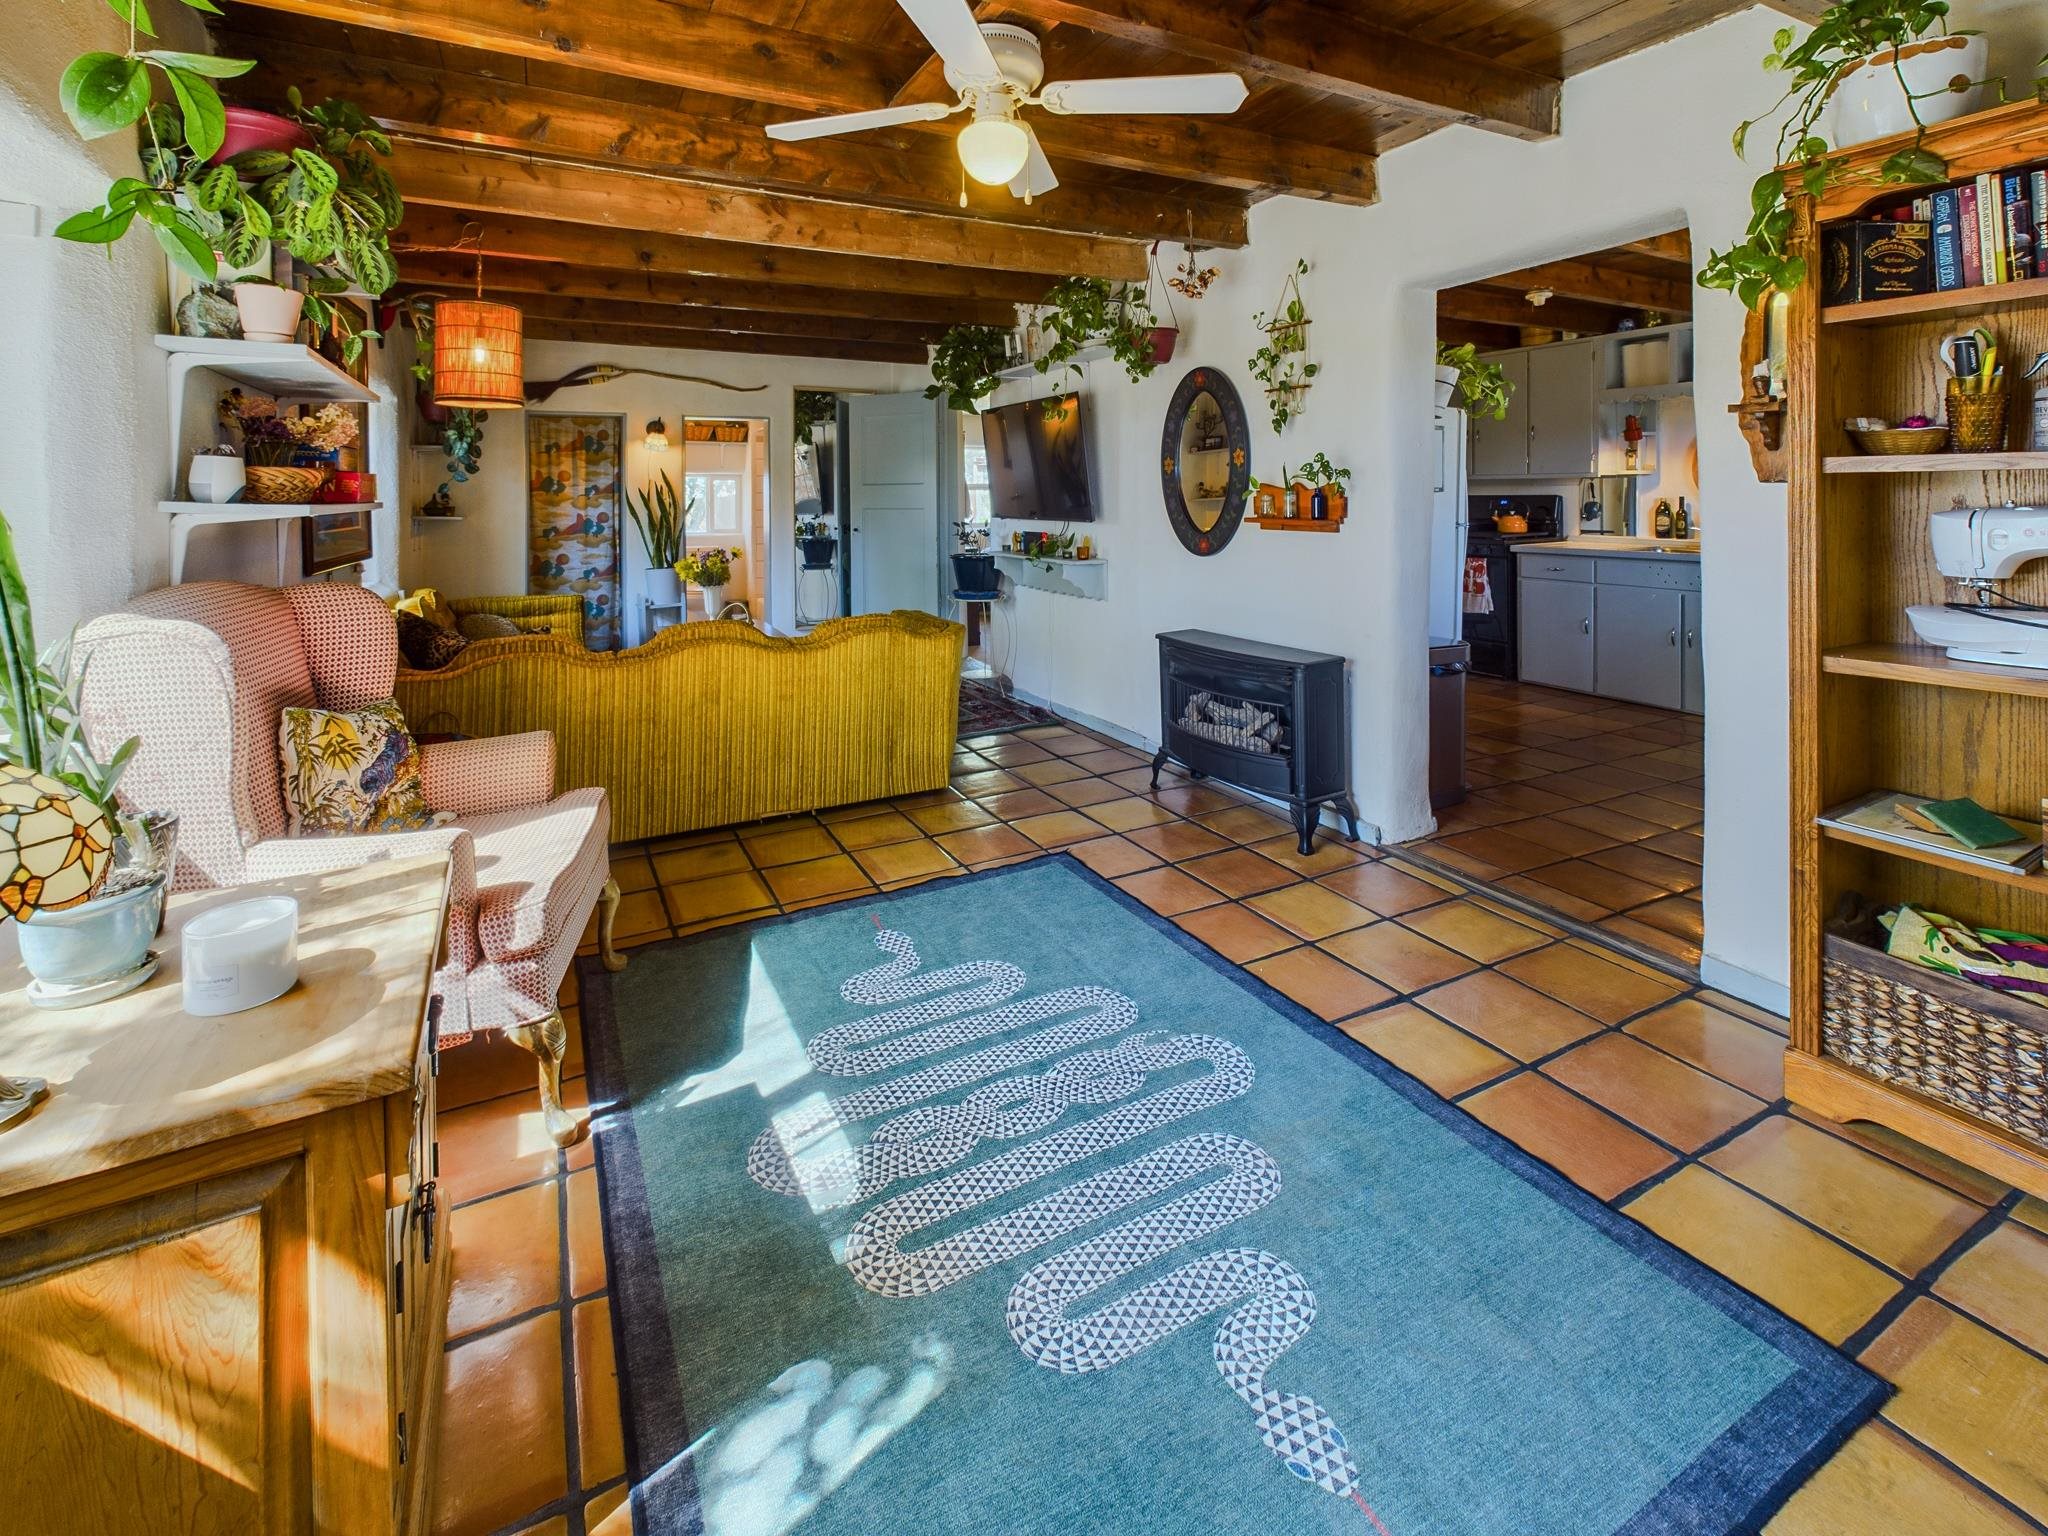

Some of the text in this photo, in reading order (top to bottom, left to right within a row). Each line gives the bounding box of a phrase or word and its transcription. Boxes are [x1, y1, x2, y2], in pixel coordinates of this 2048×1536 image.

[2005, 178, 2015, 204] Birds
[1962, 214, 1970, 238] EDWARD
[1969, 210, 1977, 231] MONKEY
[2040, 224, 2048, 249] MOORE
[1938, 236, 1955, 287] AMERICAN GODS
